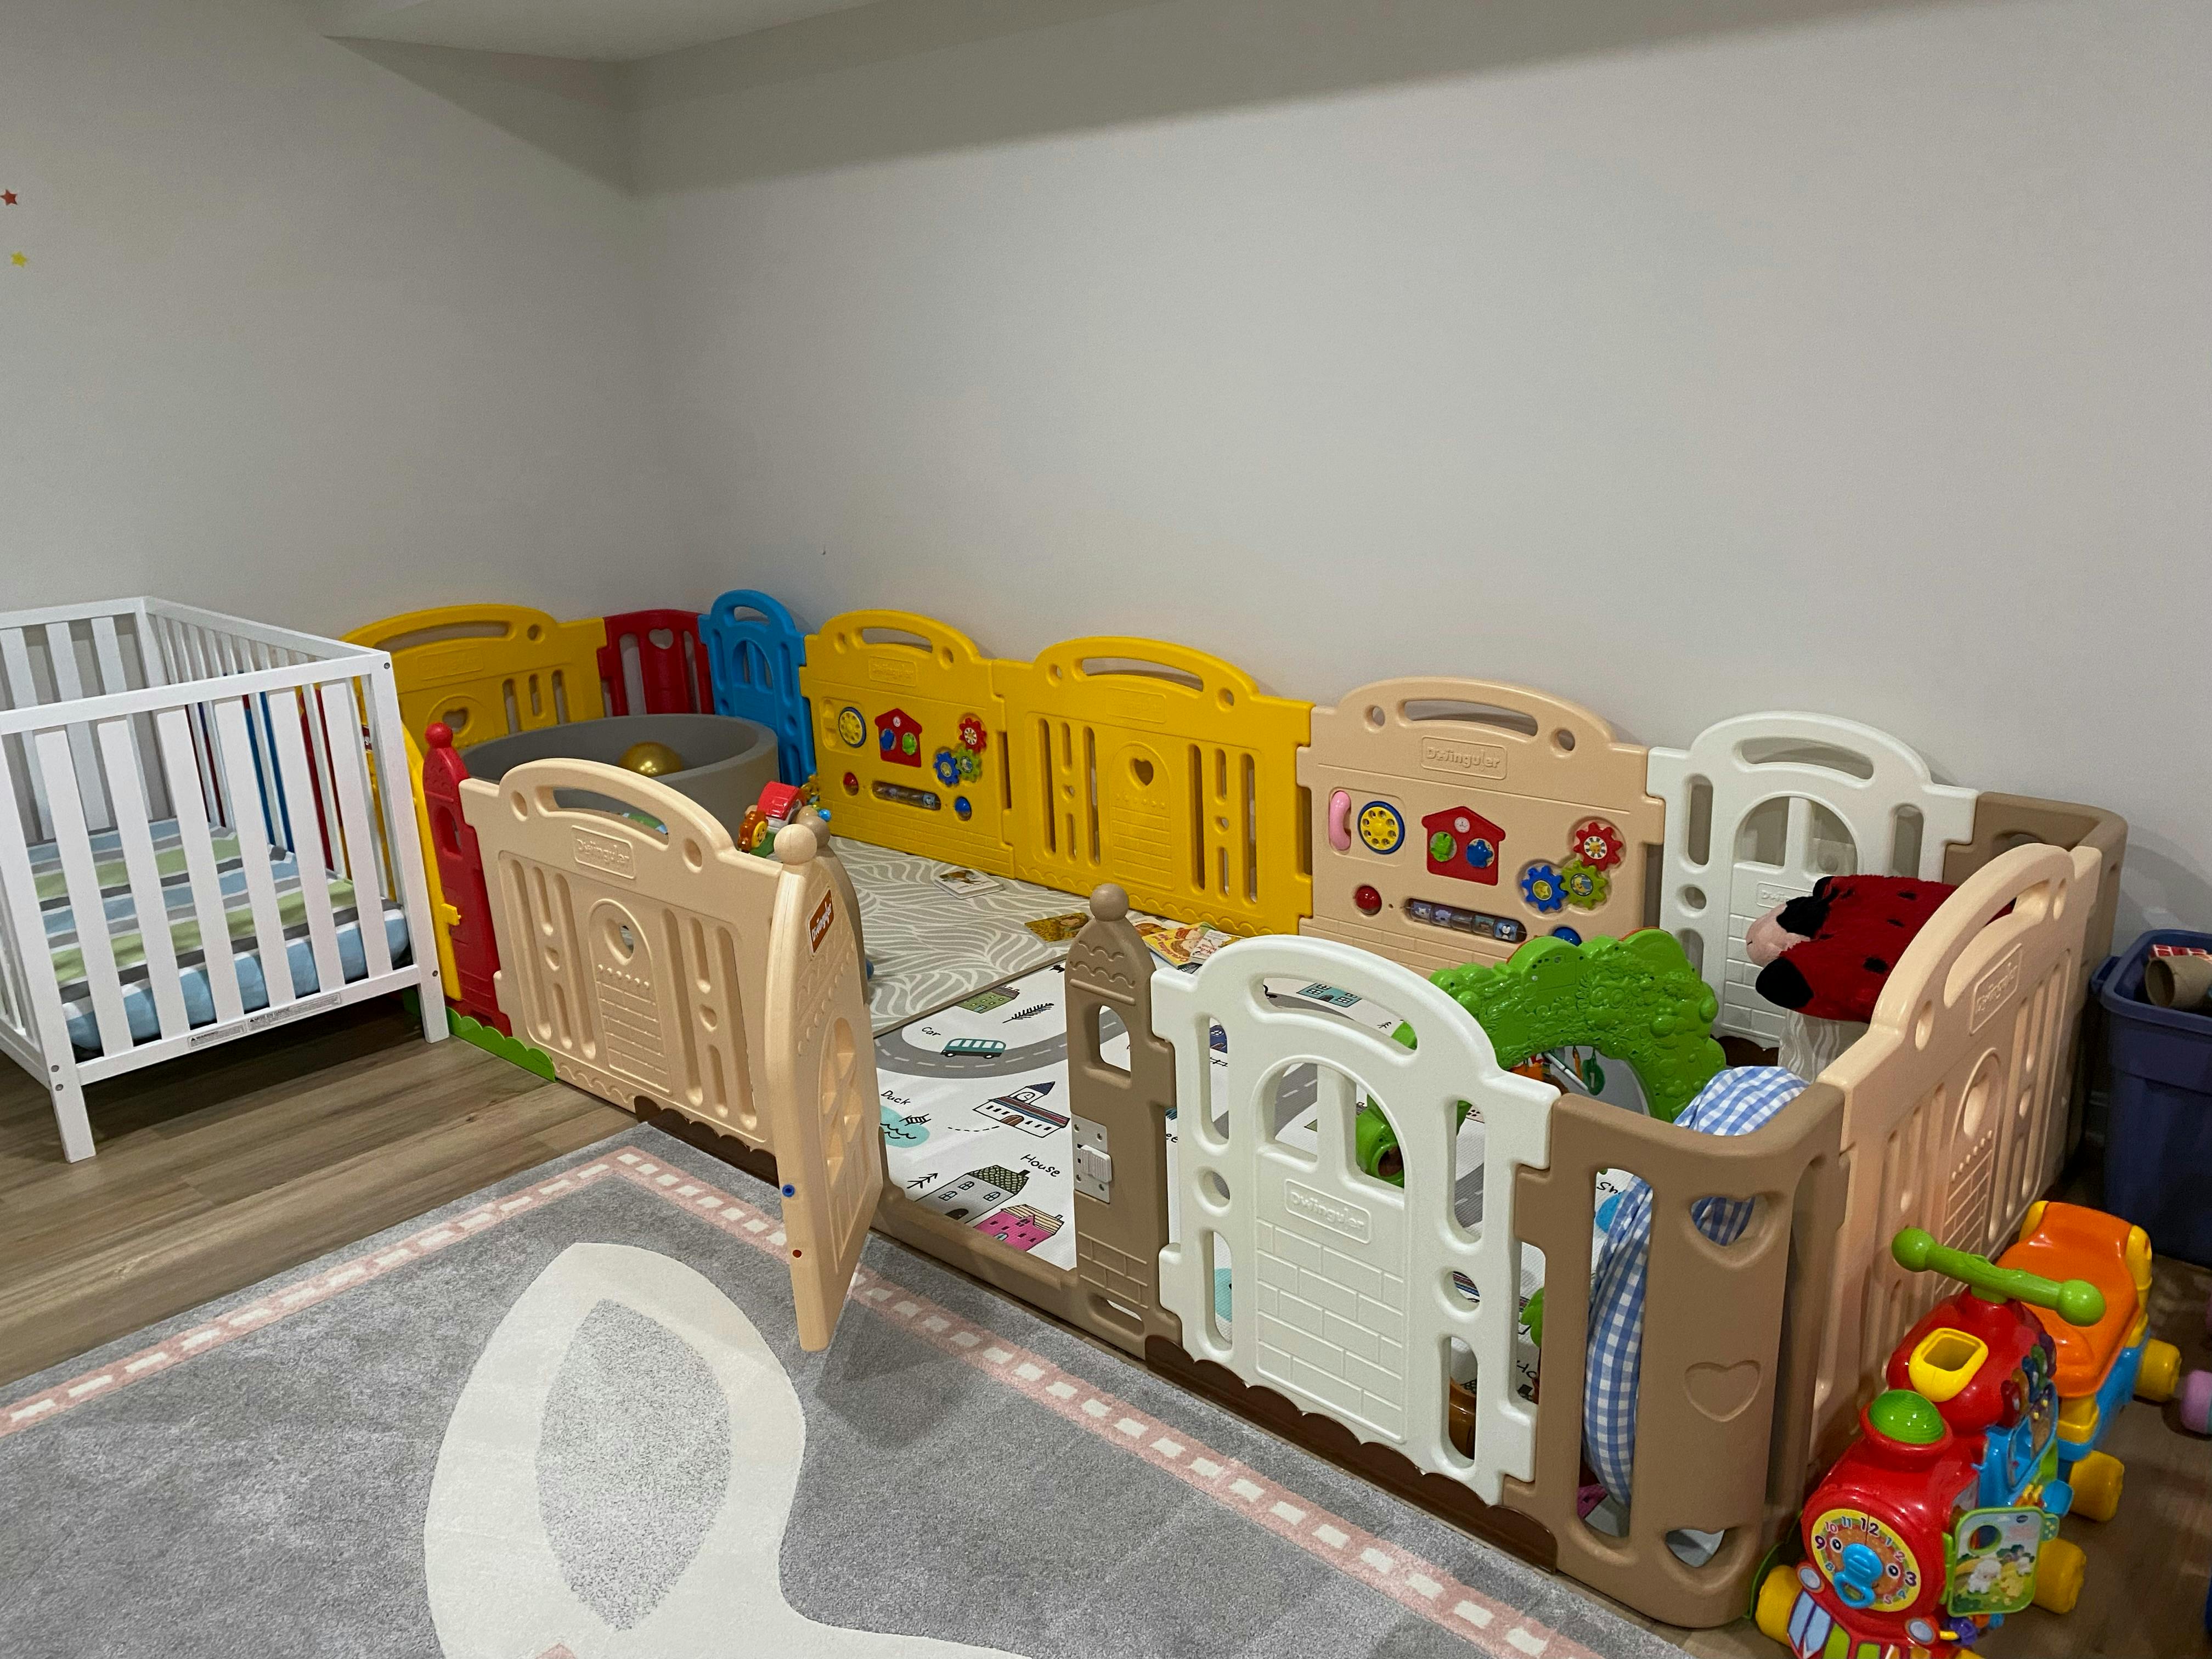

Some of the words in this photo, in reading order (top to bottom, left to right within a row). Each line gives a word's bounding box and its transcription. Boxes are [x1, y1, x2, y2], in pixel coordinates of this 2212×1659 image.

[922, 1026, 941, 1036] Car
[881, 1090, 911, 1105] Duck
[1020, 1154, 1060, 1177] House
[1825, 1521, 1838, 1534] 10
[1841, 1516, 1852, 1528] 11
[1860, 1517, 1879, 1537] 12
[1814, 1535, 1826, 1550] 9
[1893, 1551, 1905, 1562] 2
[1905, 1571, 1917, 1587] 3
